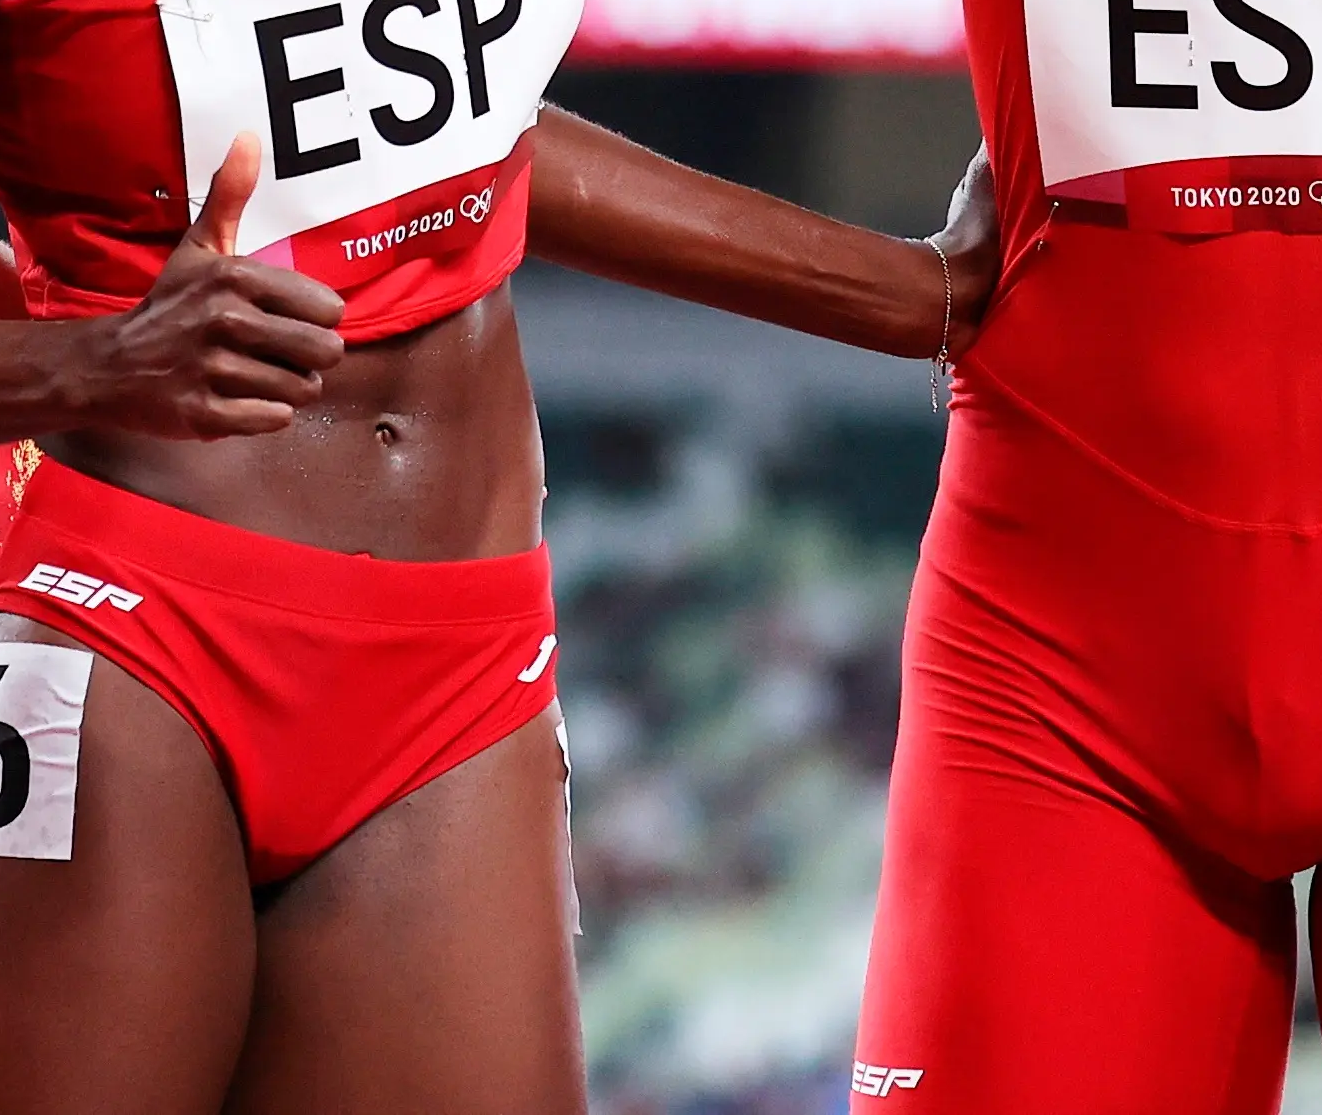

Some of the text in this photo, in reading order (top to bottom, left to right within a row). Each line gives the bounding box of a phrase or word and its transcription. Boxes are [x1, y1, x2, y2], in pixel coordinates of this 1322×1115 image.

[1170, 186, 1301, 208] TOKYO 2020
[341, 208, 454, 261] TOKYO 2020
[17, 563, 144, 612] ESP
[851, 1060, 924, 1097] ESP
